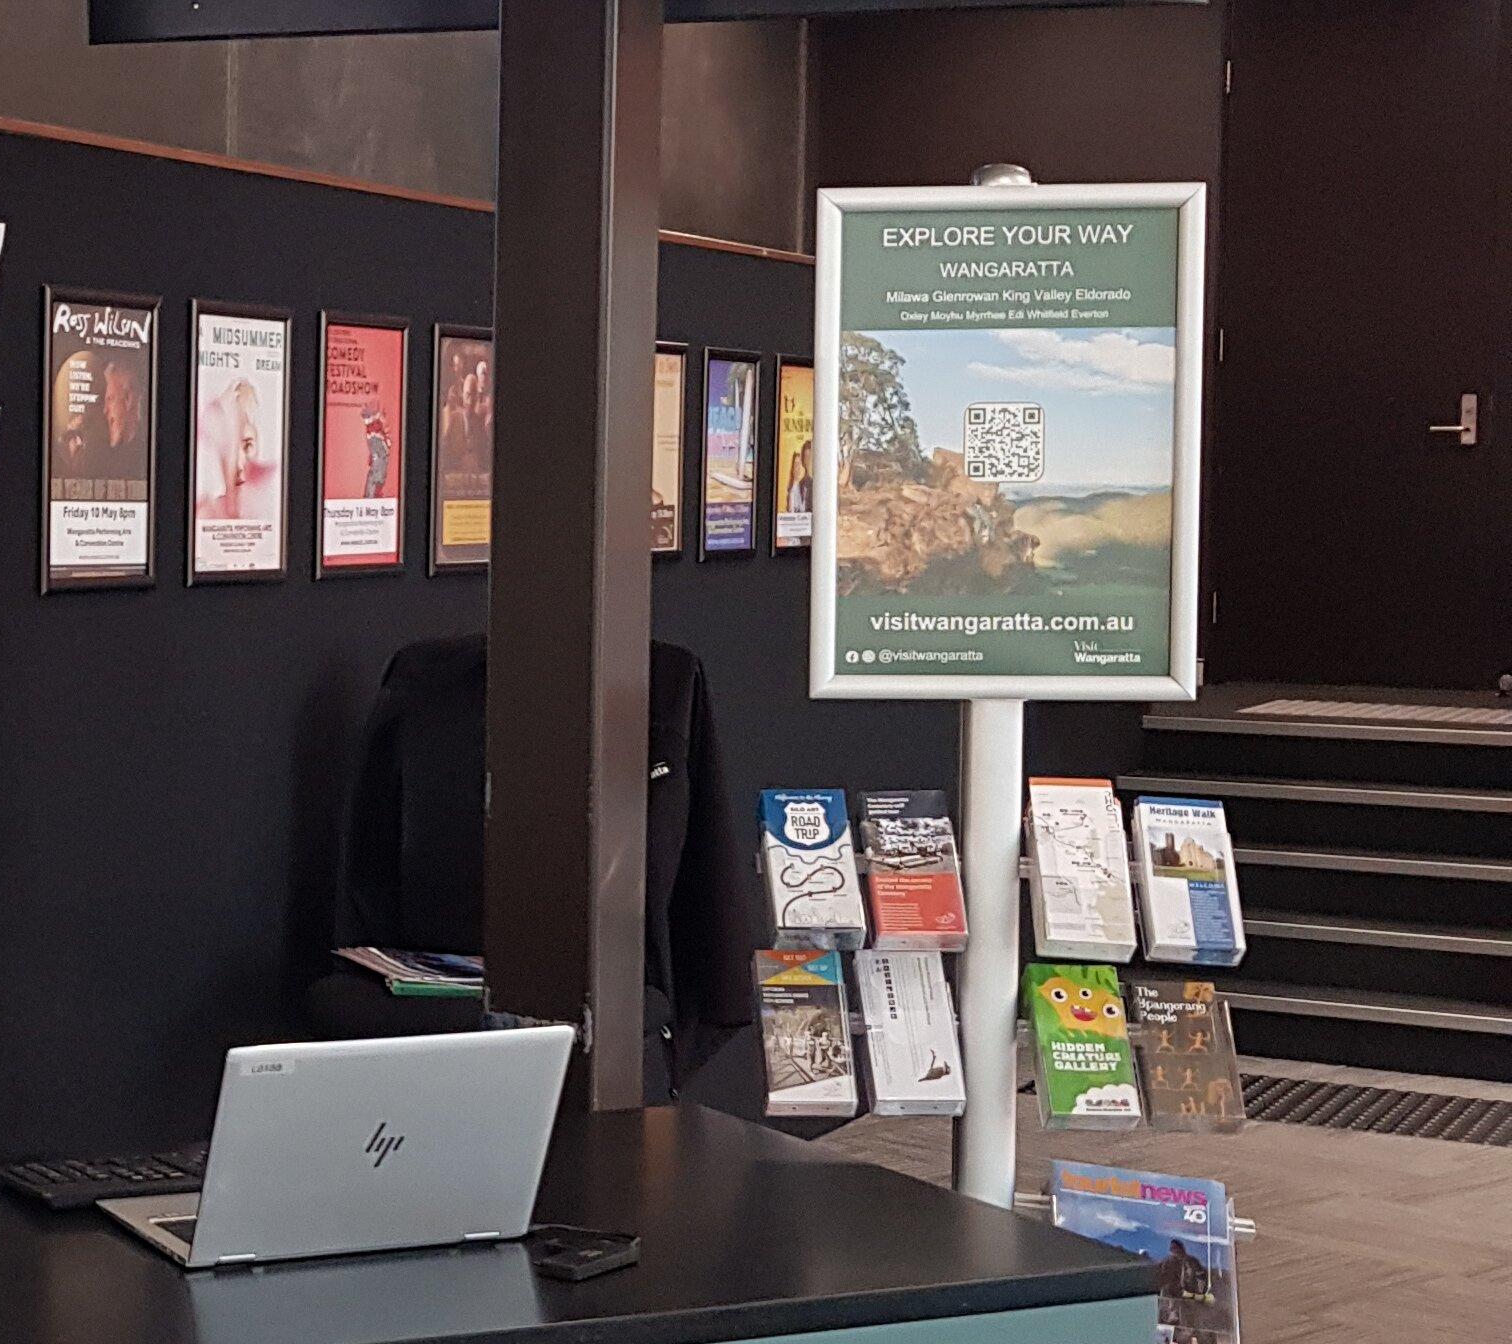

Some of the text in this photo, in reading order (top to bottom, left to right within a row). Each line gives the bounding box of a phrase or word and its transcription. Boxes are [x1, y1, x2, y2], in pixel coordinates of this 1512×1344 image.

[882, 224, 1134, 247] EXPLORE YOUR WAY
[939, 261, 1075, 278] WANGARATTA
[886, 288, 1132, 304] Milawa Glenrowan King Valley Eldorado
[1071, 309, 1109, 320] Everton
[213, 327, 282, 348] MIDSUMMER
[63, 506, 89, 521] Friday
[101, 507, 117, 521] May
[869, 612, 1134, 636] visitwangaratta.com.au
[878, 648, 984, 665] @visitwangaratta
[1074, 652, 1142, 665] Wangaratta
[1149, 806, 1216, 818] Heritage Walk
[791, 815, 820, 827] ROAD
[794, 828, 819, 839] TRIP
[1135, 986, 1158, 997] The
[1139, 1011, 1178, 1024] People
[1051, 1041, 1106, 1053] HIDDEN
[1052, 1051, 1121, 1062] CREATURE
[1054, 1061, 1118, 1072] GALLERY
